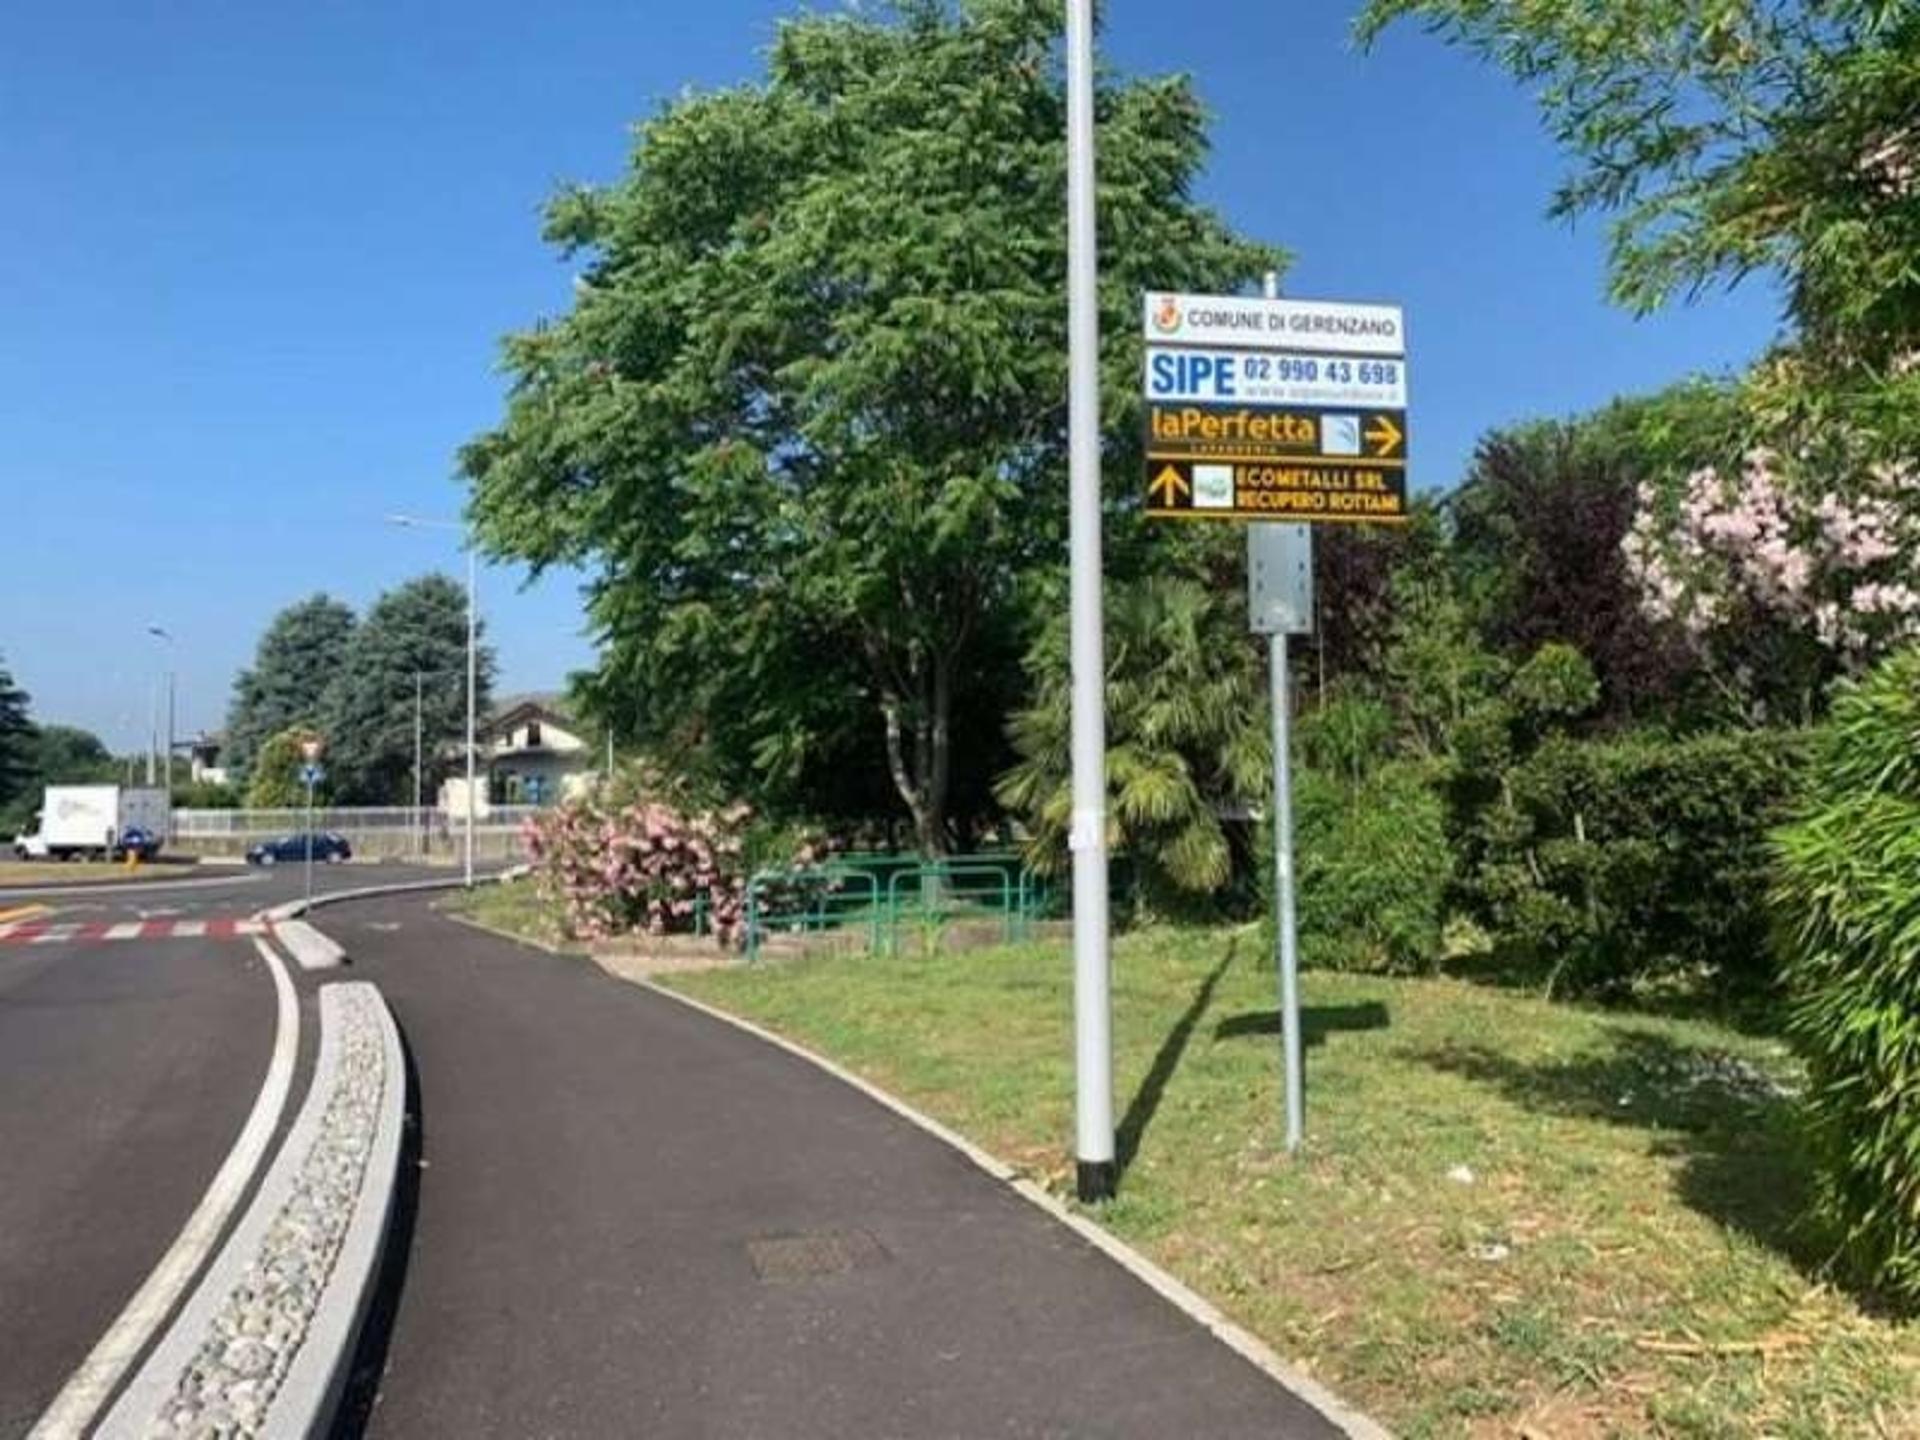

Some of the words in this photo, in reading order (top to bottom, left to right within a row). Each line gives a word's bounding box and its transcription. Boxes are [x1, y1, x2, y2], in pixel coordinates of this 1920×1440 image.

[1188, 310, 1263, 330] COMUNE
[1268, 315, 1285, 331] DI
[1289, 315, 1396, 336] GERENZANO
[1152, 354, 1236, 396] SIPE
[1244, 358, 1270, 380] 02
[1278, 359, 1318, 382] 990
[1324, 361, 1351, 383] 43
[1358, 363, 1397, 385] 698
[1152, 406, 1315, 441] laPerfetta
[1235, 465, 1350, 489] ECOMETALLI
[1355, 470, 1387, 490] SRL
[1235, 489, 1325, 509] RECUPERO
